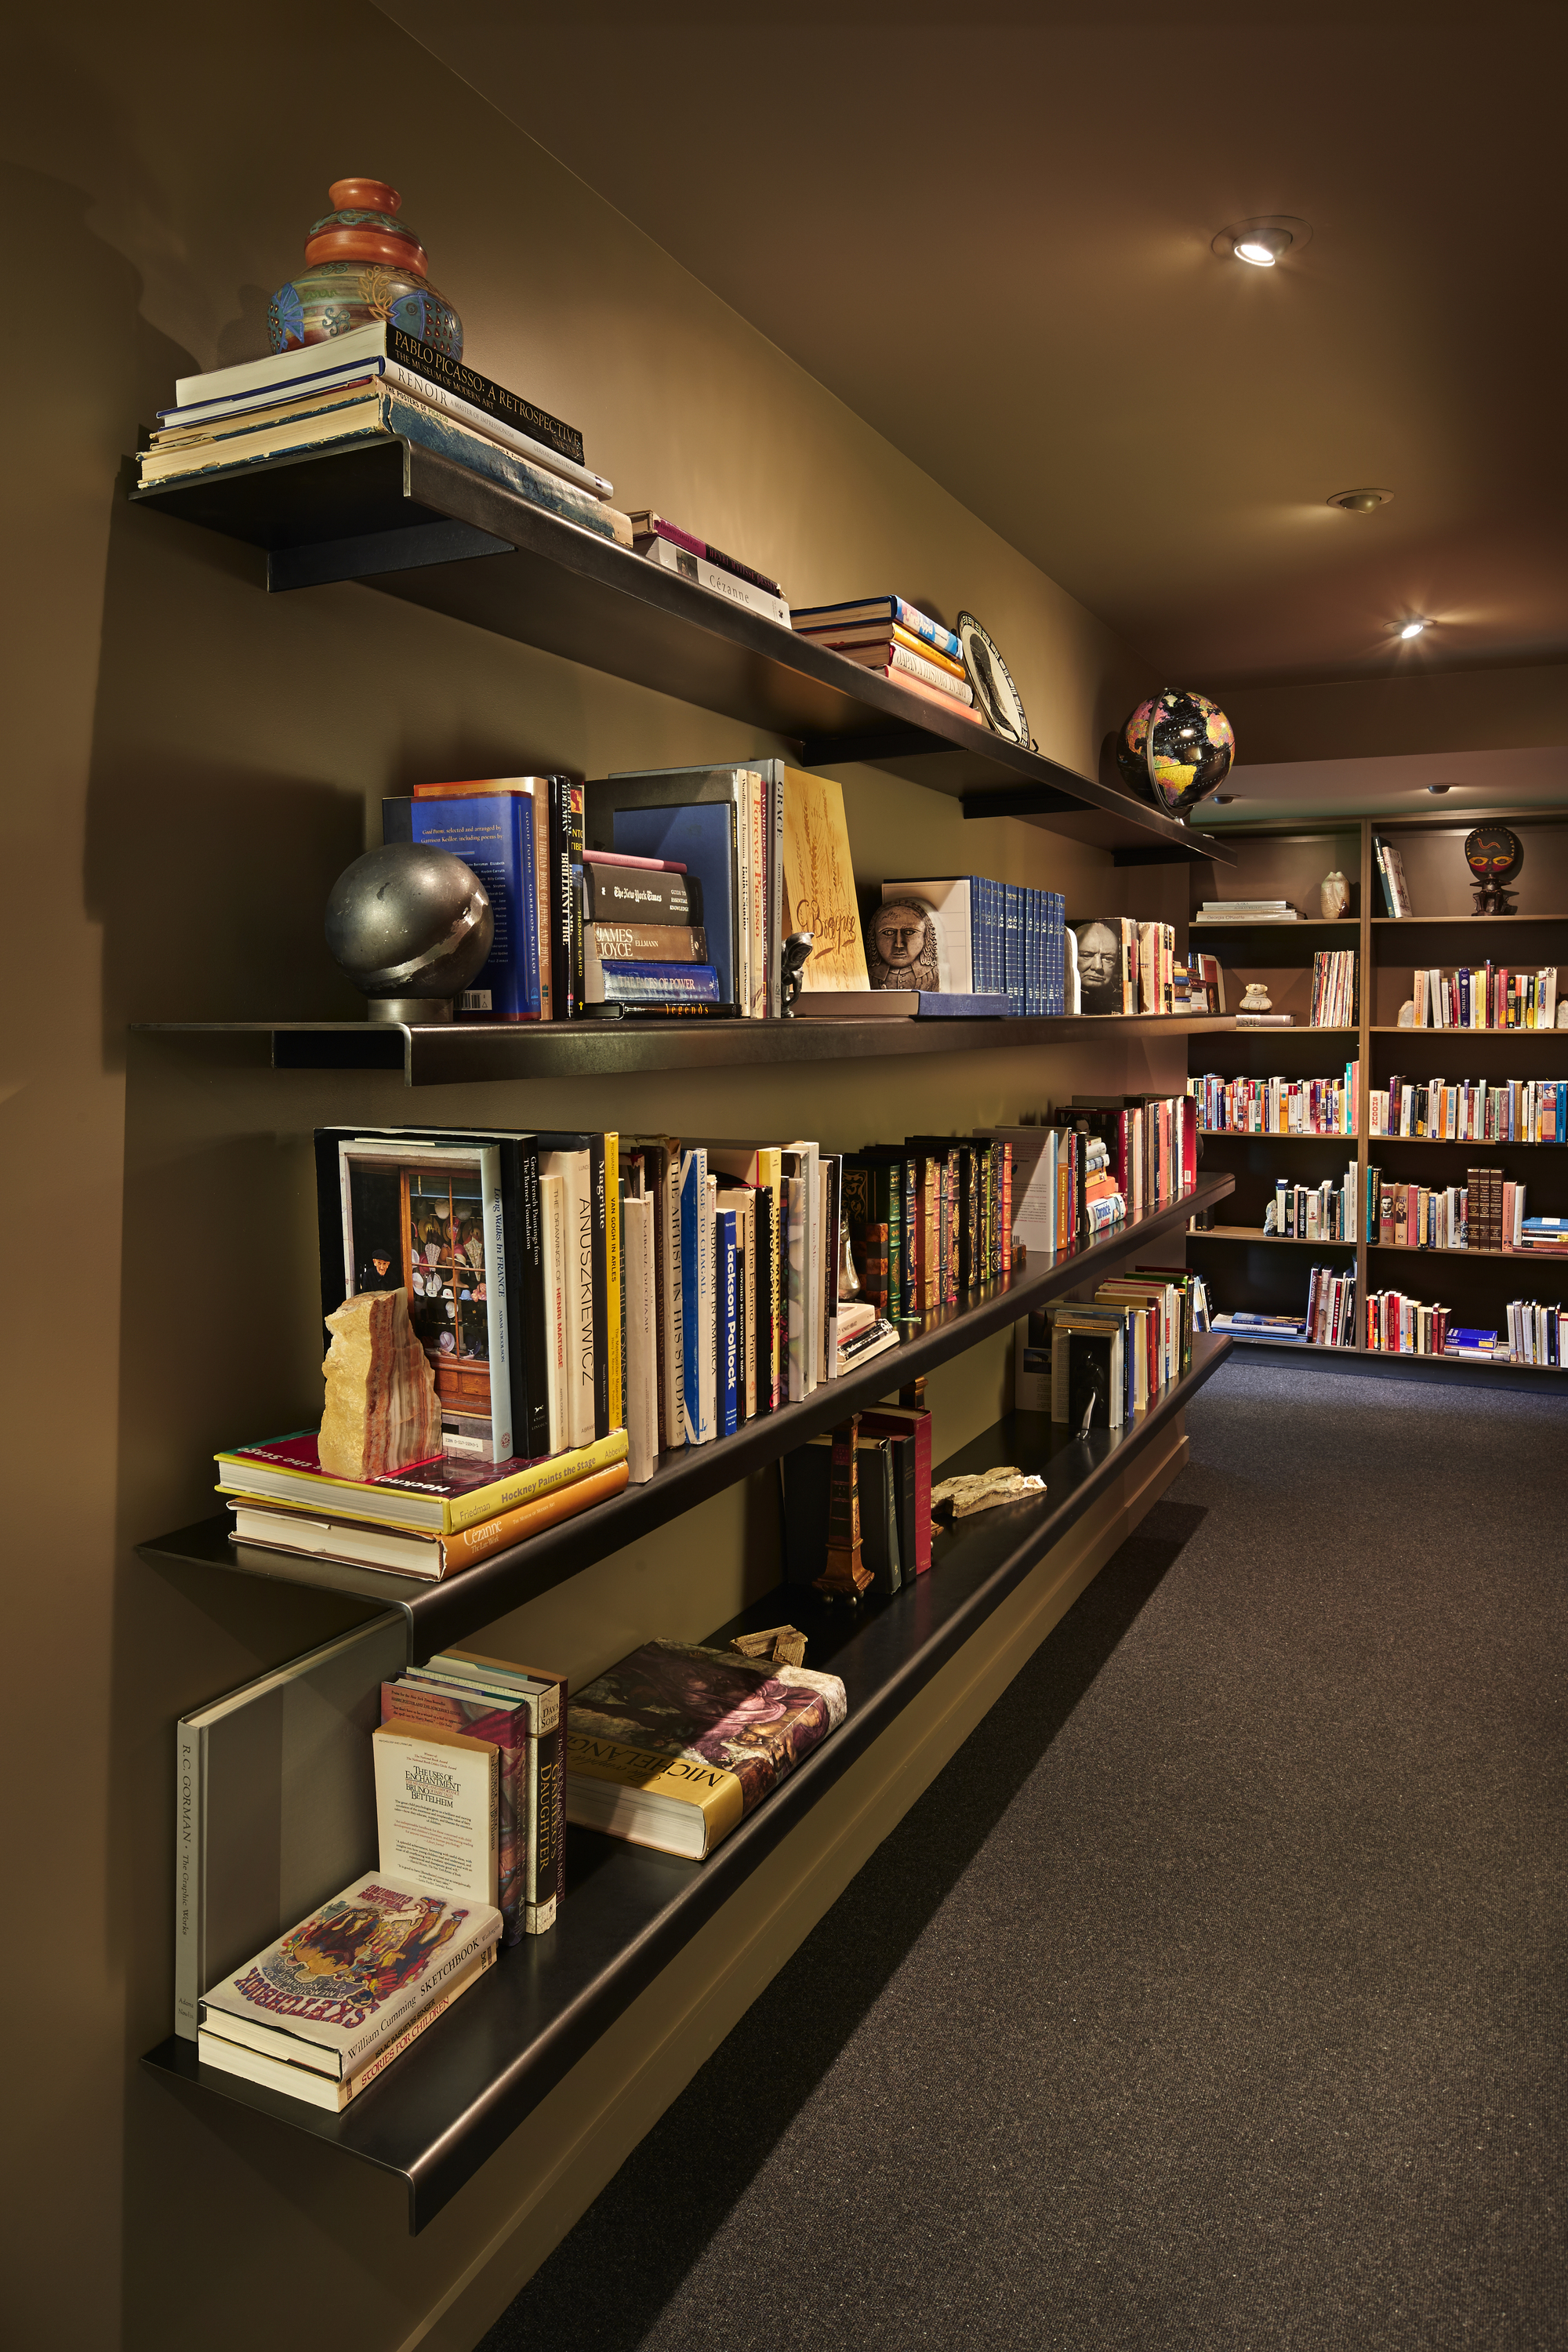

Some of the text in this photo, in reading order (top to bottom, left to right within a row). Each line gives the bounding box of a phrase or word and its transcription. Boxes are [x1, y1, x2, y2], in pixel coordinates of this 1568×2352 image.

[395, 350, 495, 410] THE MUSEUM OF MODERN ART
[395, 330, 580, 446] PABLO PICASSO: A RETROSPECTIVE
[397, 367, 448, 406] RENOIR
[385, 384, 448, 423] THE POSTERS OF PICASSO
[710, 575, 750, 604] Cézanne
[539, 825, 547, 839] THE
[539, 872, 548, 891] BOOK
[540, 902, 549, 927] LIVING
[597, 928, 633, 942] JAMES
[601, 942, 633, 956] JOYCE
[618, 976, 695, 989] THE FACES OF POWER
[666, 1004, 709, 1015] legends
[492, 1189, 502, 1211] Long
[596, 1160, 605, 1229] Magritte
[1096, 1201, 1111, 1219] Chronicle
[700, 1215, 706, 1232] TO
[671, 1206, 681, 1273] ARTIST
[750, 1231, 755, 1243] of
[496, 1243, 503, 1254] In
[612, 1243, 617, 1253] IN
[555, 1270, 561, 1283] OF
[579, 1198, 593, 1386] ANUSZKIEWICZ
[673, 1282, 682, 1302] IN
[710, 1301, 717, 1314] IN
[673, 1308, 682, 1344] HIS
[728, 1320, 737, 1389] Pollock
[674, 1348, 684, 1424] STUDIO
[238, 1447, 281, 1461] Stage
[604, 1444, 627, 1460] Abbeville
[283, 1457, 312, 1468] the
[373, 1475, 451, 1493] Hockney
[502, 1457, 596, 1504] Hockney Paints the Stage
[459, 1502, 491, 1521] Friedman
[463, 1520, 503, 1546] Cézanne
[470, 1535, 499, 1554] The Late Work
[543, 1704, 559, 1717] DAVA
[405, 1770, 461, 1792] ENCHANTMENT
[413, 1766, 453, 1782] THE USES OF
[182, 1744, 191, 1842] R.C. GORMAN
[406, 1784, 430, 1795] BRUNO
[412, 1791, 453, 1808] BETTELHEIM
[539, 1762, 552, 1872] DAUGHTER
[180, 1872, 189, 1905] Graphic
[364, 1884, 414, 1905] CUMMING
[358, 1891, 404, 1911] WILLIAM
[234, 1965, 381, 2029] SKETCHBOOK
[348, 1937, 480, 2060] William Cumming SKETCHBOOK
[375, 1999, 436, 2059] ISAAC BASHEVIS SINGER
[361, 1996, 450, 2085] STORIES FOR CHILDREN
